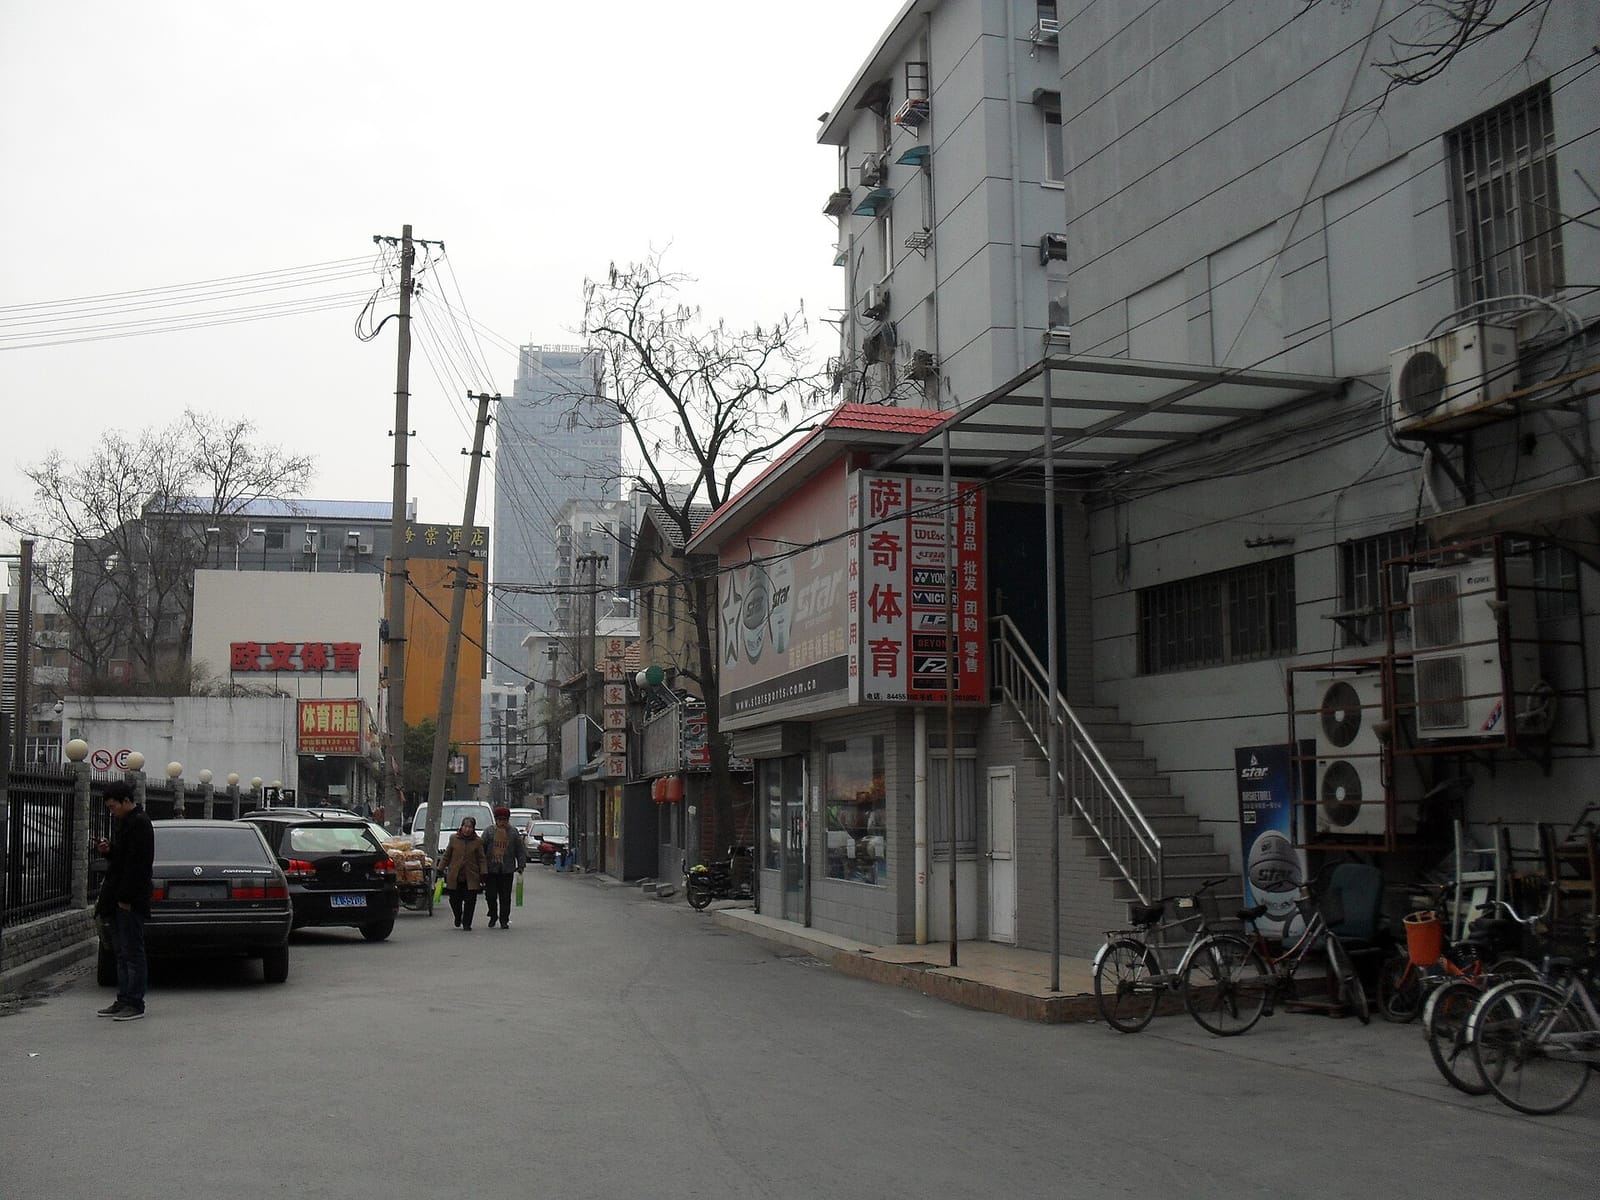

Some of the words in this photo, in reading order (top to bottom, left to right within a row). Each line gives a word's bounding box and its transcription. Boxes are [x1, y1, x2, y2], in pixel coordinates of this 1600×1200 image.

[848, 494, 859, 677] 萨奇体育用品
[868, 479, 902, 678] 萨奇体育
[930, 572, 957, 584] YONX
[964, 560, 978, 591] 批发
[772, 585, 791, 608] star
[795, 569, 844, 622] star
[924, 592, 958, 605] VICTR
[964, 600, 978, 632] 团购
[230, 641, 361, 672] 欧文体育
[964, 642, 979, 673] 零售
[735, 682, 817, 710] www.starsports.com.cn
[302, 704, 359, 733] 体育用品
[1241, 767, 1268, 778] star
